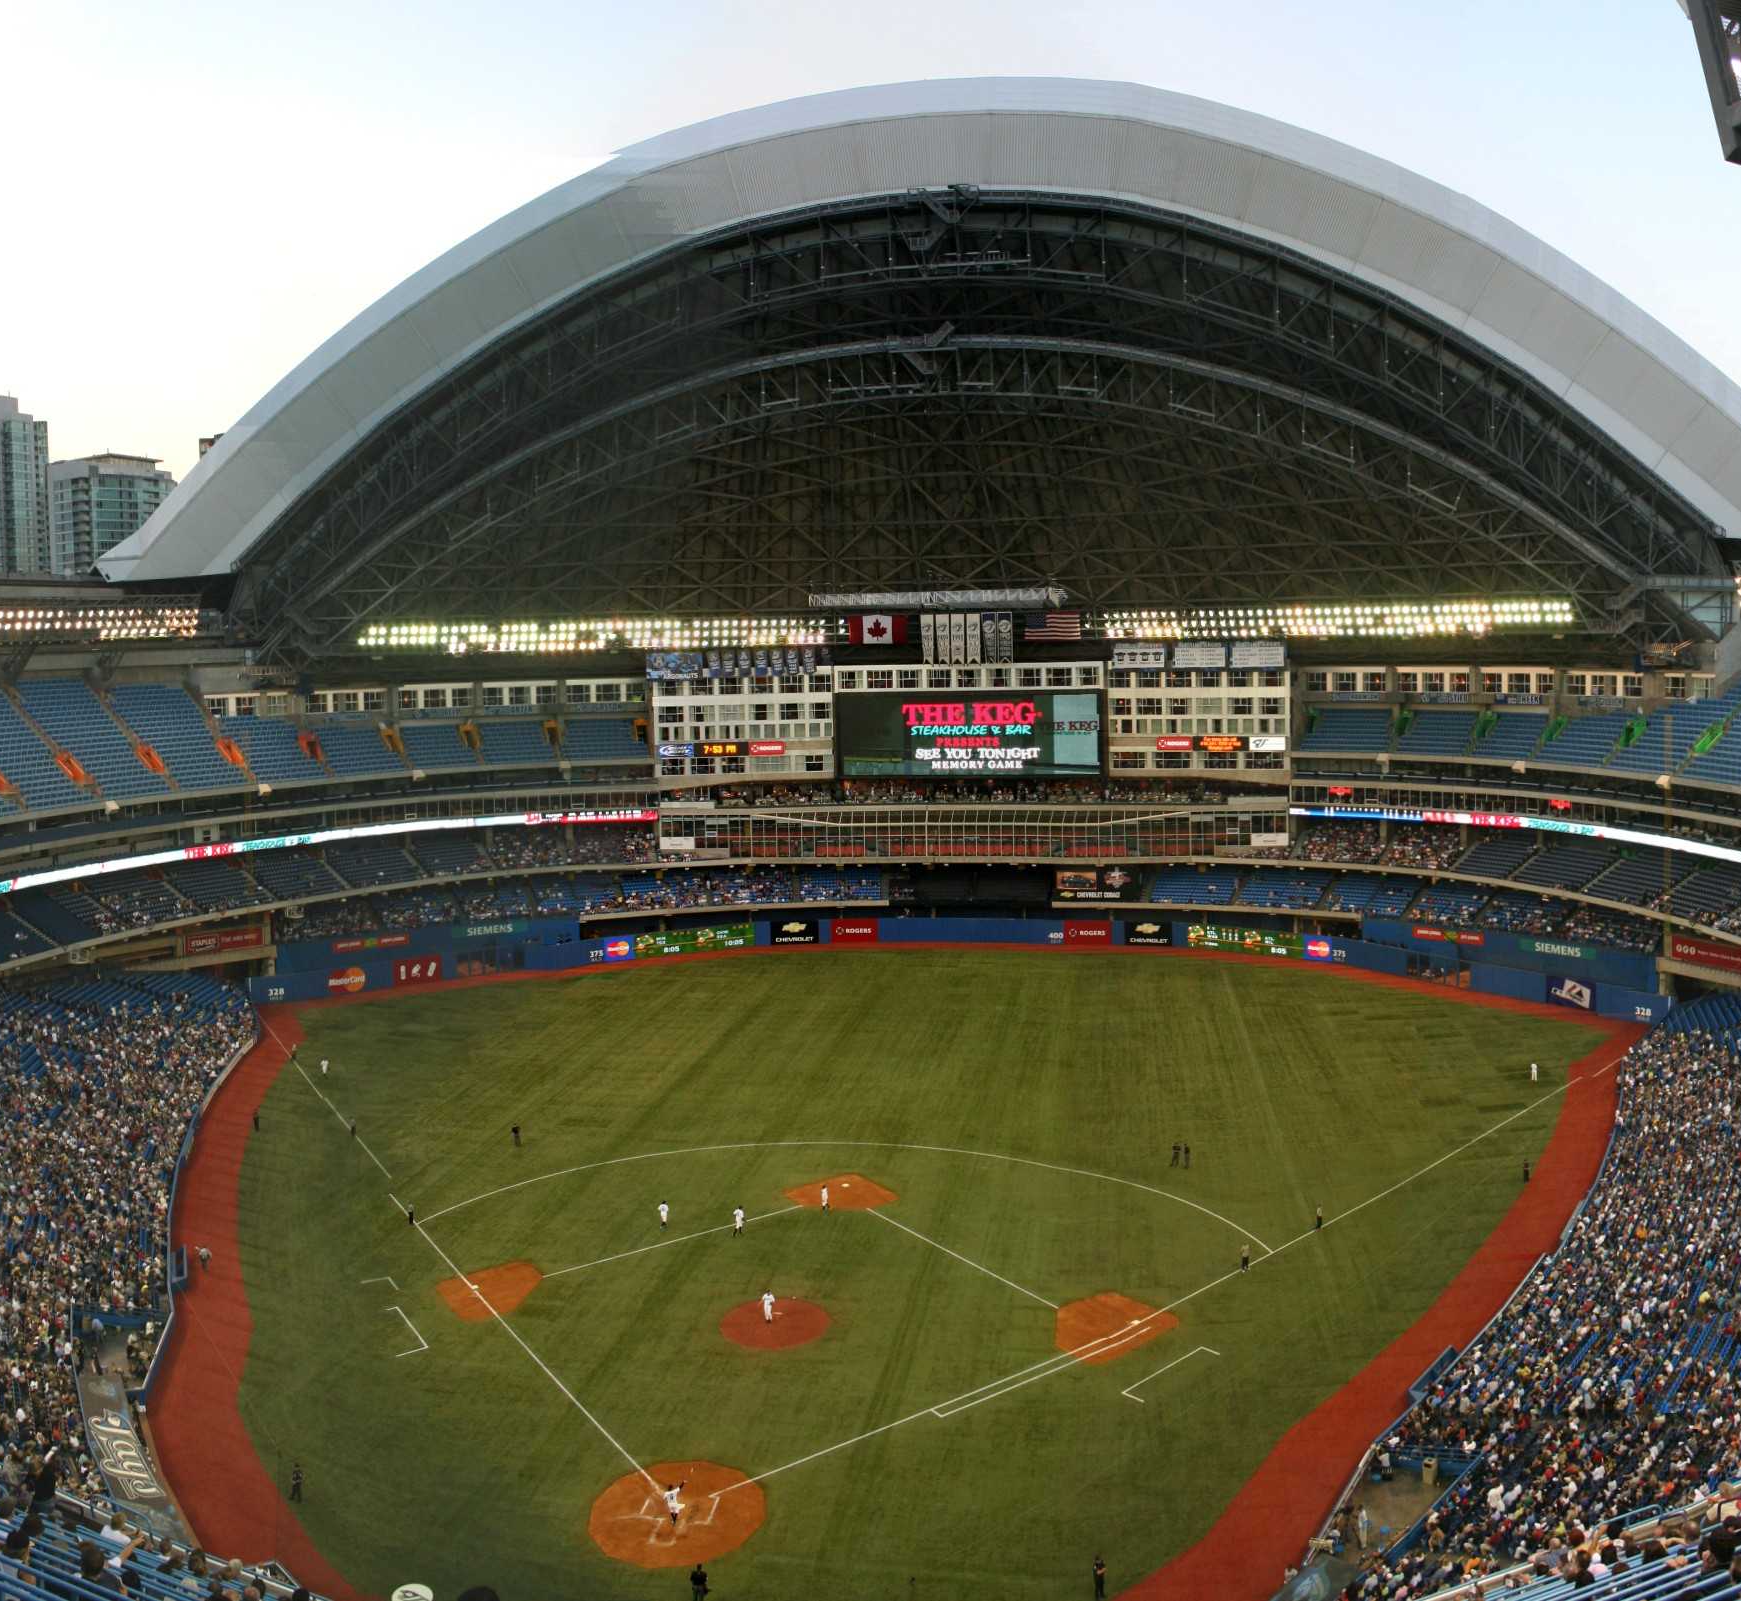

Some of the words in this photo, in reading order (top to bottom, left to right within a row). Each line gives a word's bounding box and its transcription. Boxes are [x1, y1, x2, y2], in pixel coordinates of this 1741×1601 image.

[902, 703, 965, 725] THE
[971, 702, 1036, 725] KEG
[910, 725, 988, 736] STEAKHOUSE
[990, 725, 1002, 736] &
[1005, 725, 1032, 736] BAR
[936, 736, 1000, 747] PRESENTS
[915, 748, 942, 760] SEE
[944, 748, 972, 760] YOU
[977, 747, 1041, 760] TONIGHT
[931, 760, 984, 769] MEMORY
[987, 760, 1024, 769] GAME
[466, 924, 513, 936] SIEMENS
[1534, 942, 1581, 957] SIEMENS
[328, 974, 366, 986] MasterCard
[267, 988, 285, 997] 328
